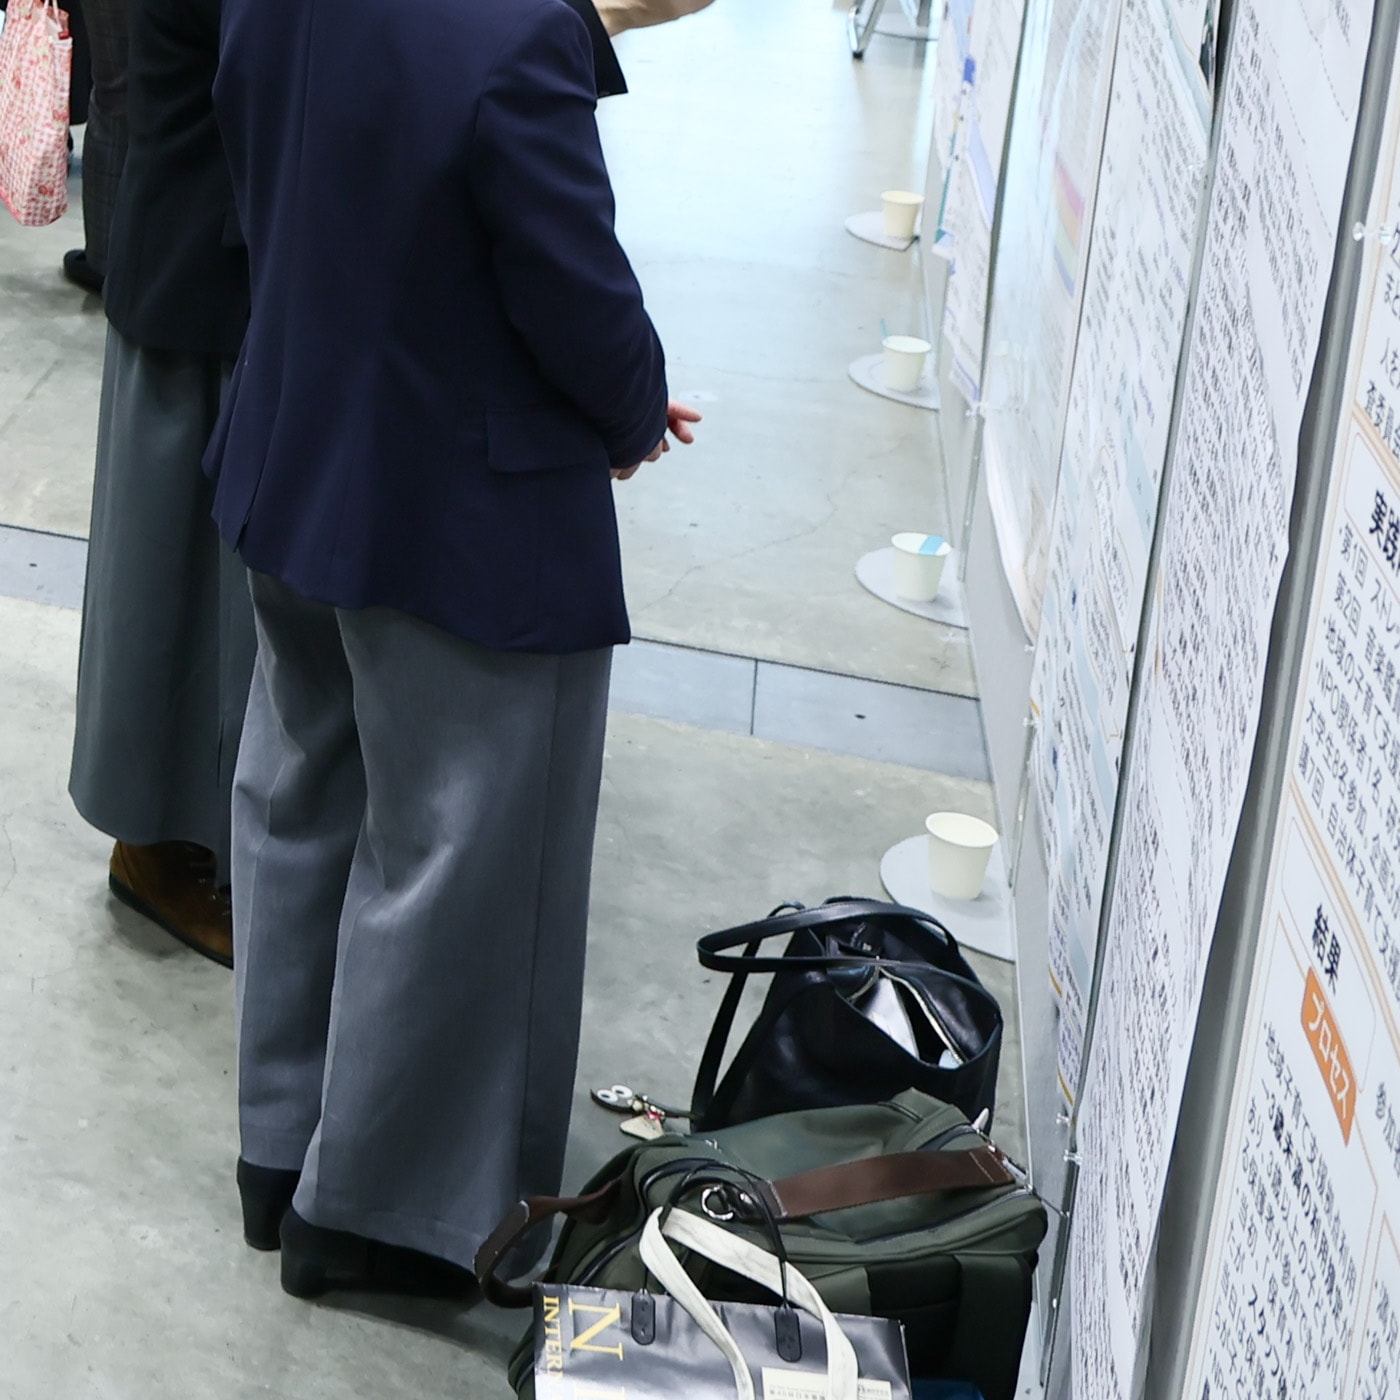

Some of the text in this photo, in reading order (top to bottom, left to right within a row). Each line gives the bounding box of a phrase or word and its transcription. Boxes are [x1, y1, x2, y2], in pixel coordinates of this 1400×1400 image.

[1312, 903, 1341, 996] 結果
[1309, 991, 1351, 1120] プロセス
